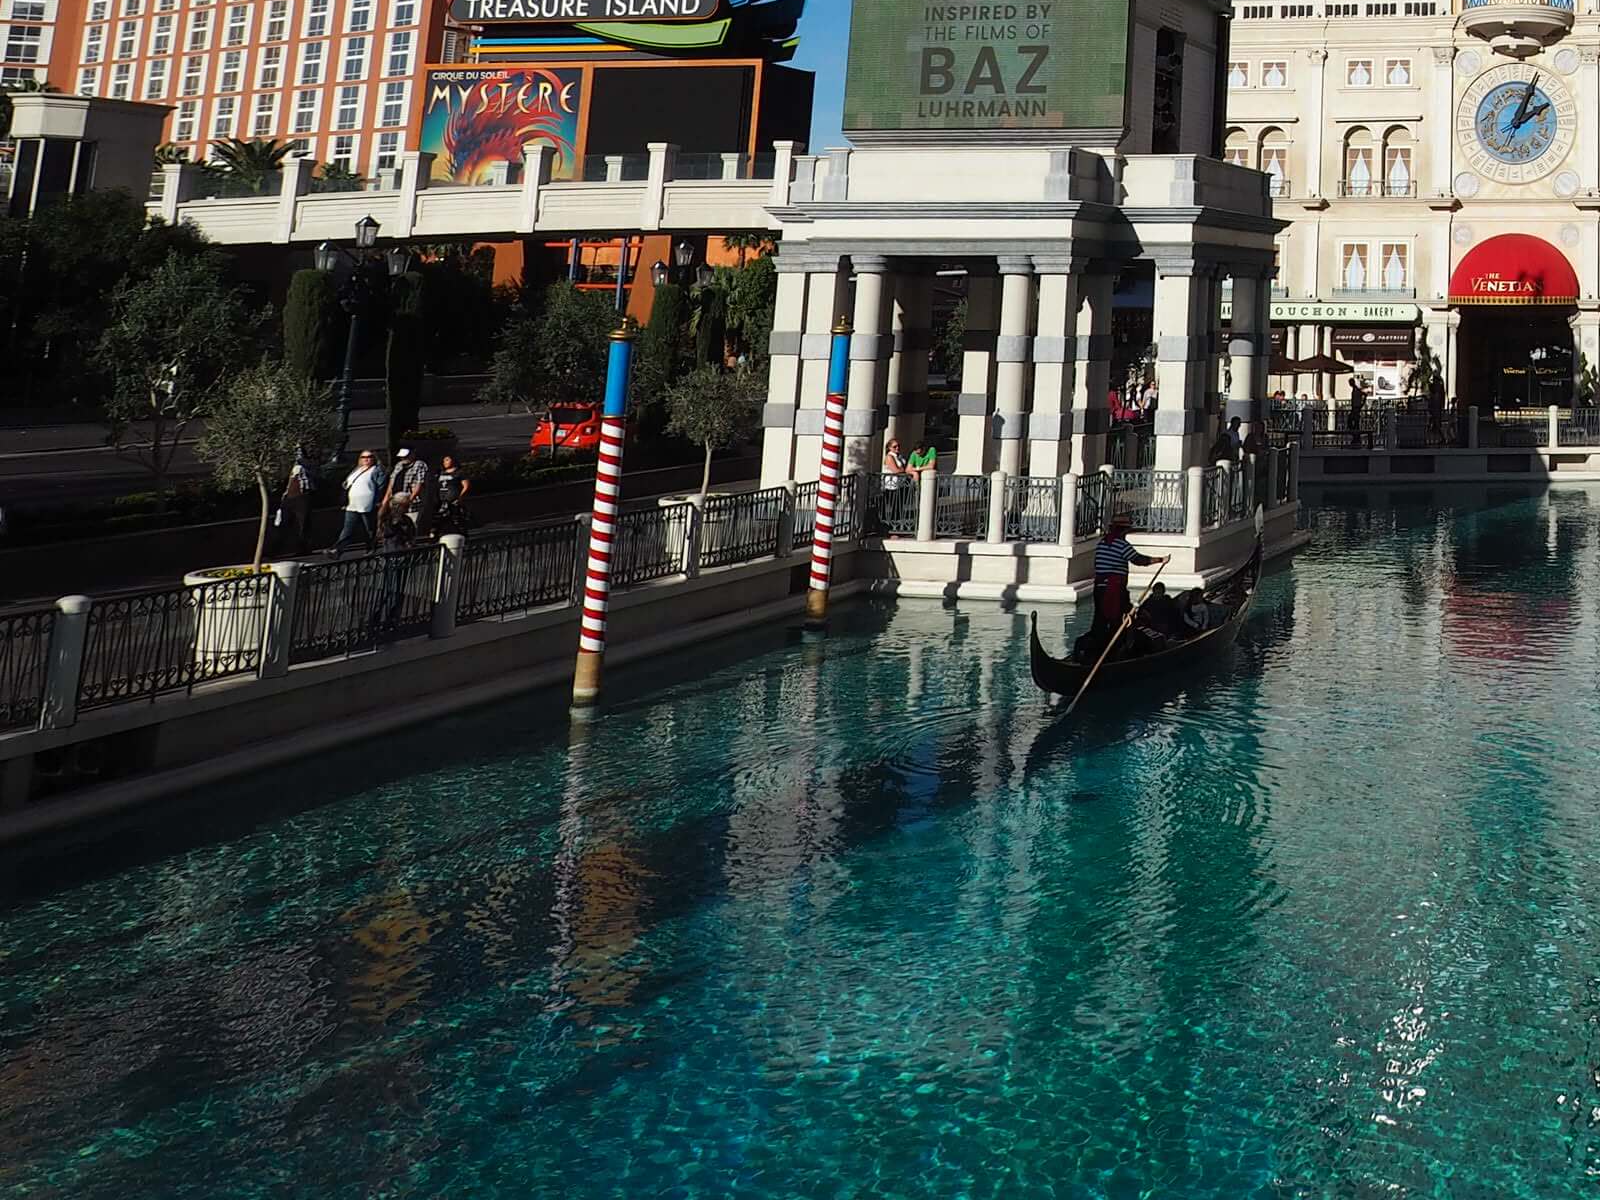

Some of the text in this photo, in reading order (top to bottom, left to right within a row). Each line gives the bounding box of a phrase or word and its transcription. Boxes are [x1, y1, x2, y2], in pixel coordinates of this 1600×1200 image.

[924, 4, 1052, 21] INSPIRED BY
[924, 23, 1051, 42] THE FILMS OF
[432, 71, 511, 81] CIRQUE DU SOLEIL
[919, 44, 1051, 96] BAZ
[427, 76, 576, 114] MYSTÈRE
[917, 99, 1047, 119] LUHRMANN
[1275, 307, 1394, 317] OUCHON BAKERY
